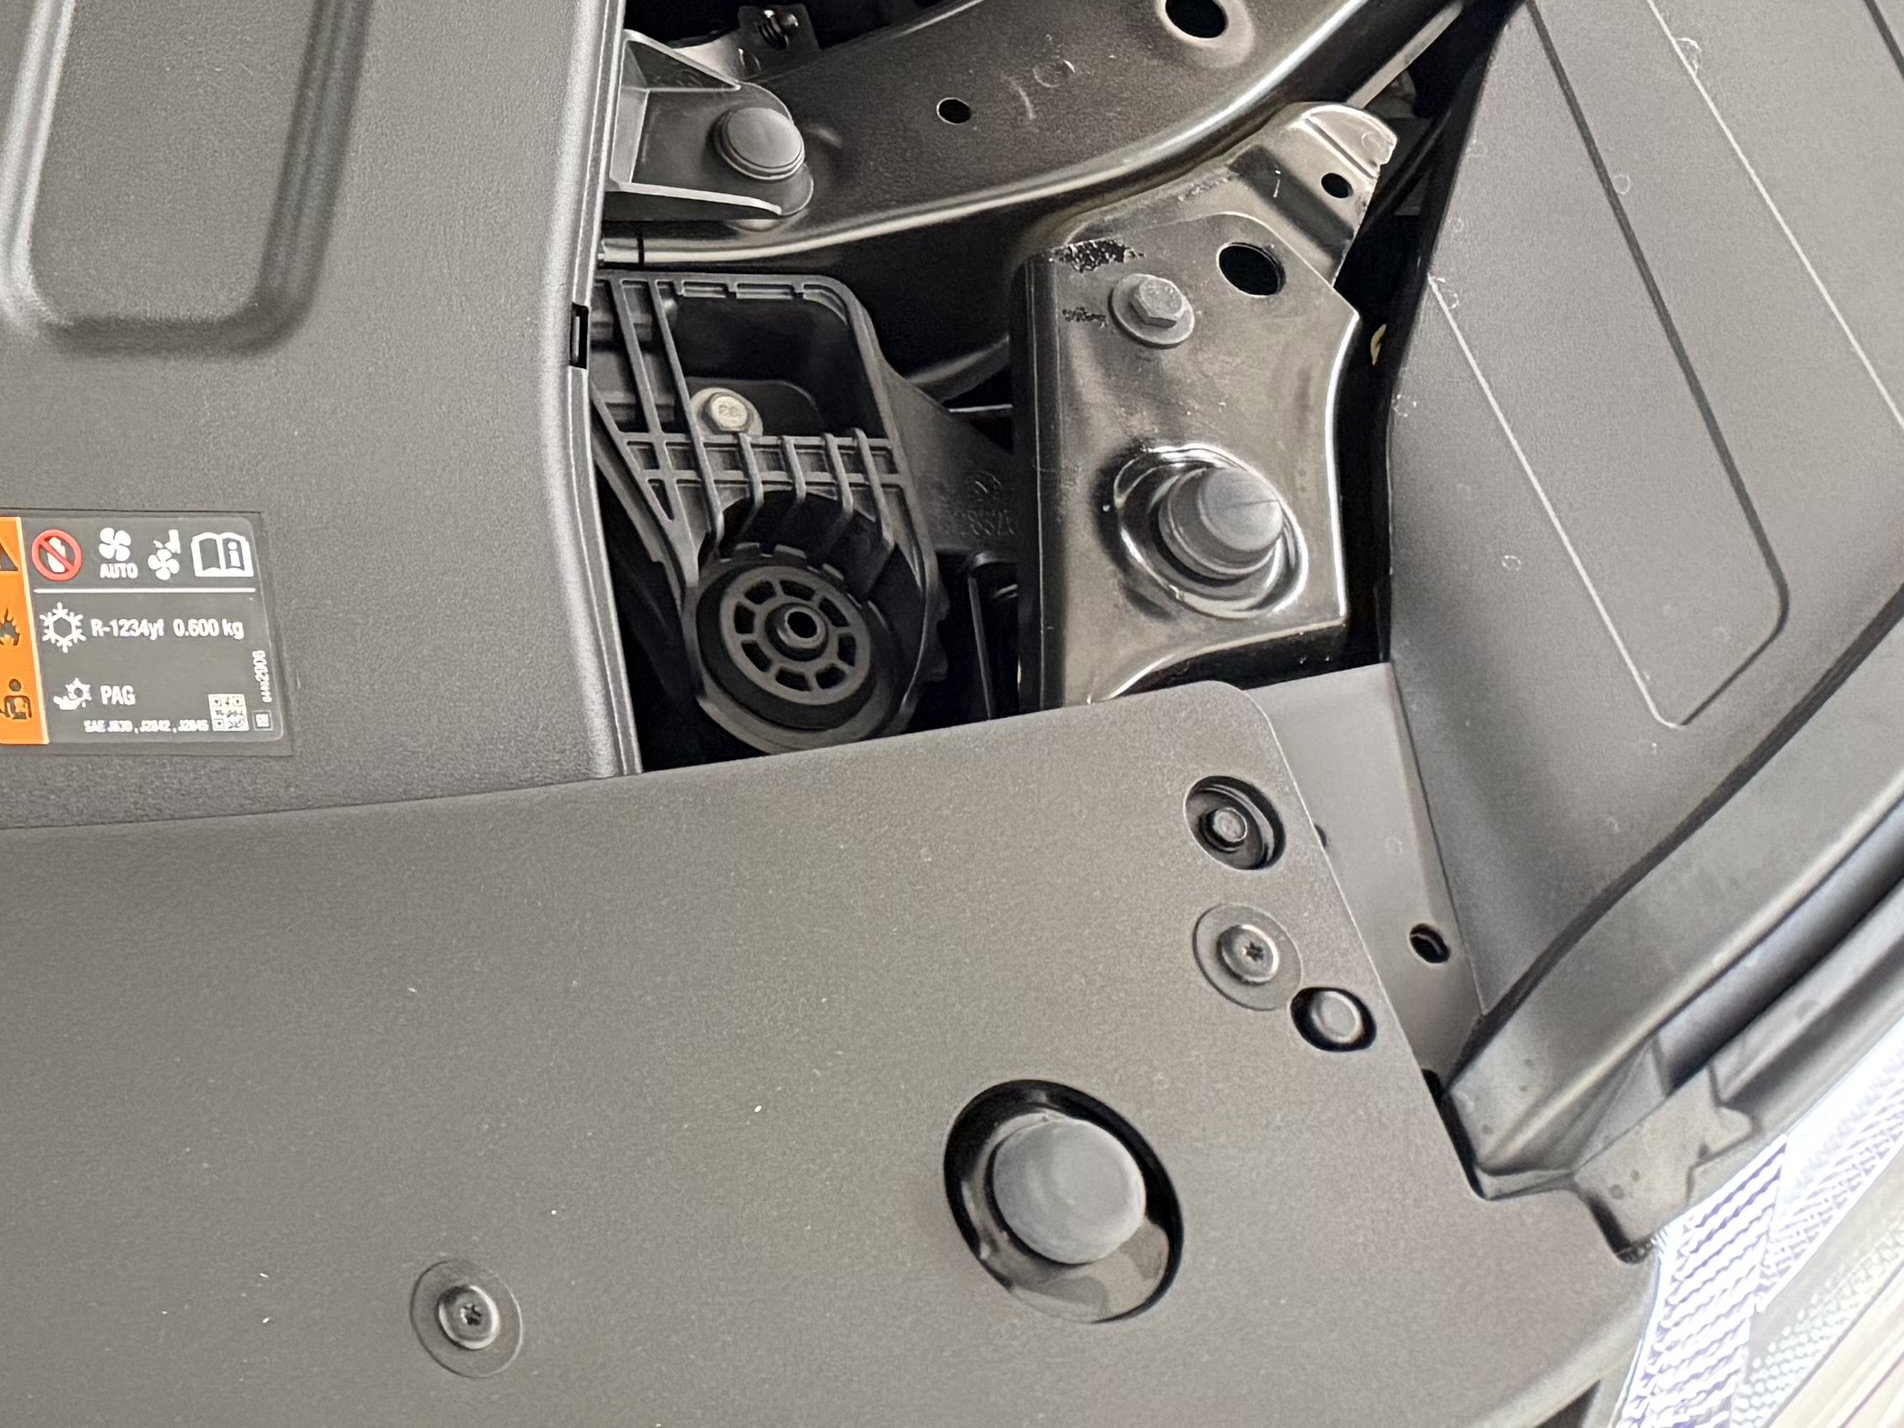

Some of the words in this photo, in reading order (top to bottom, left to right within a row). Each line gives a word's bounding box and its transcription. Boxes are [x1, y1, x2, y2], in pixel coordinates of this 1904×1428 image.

[99, 562, 138, 579] AUTO
[91, 619, 164, 640] R-1234yf
[173, 619, 220, 636] 0.600
[222, 619, 245, 640] kg
[100, 685, 137, 706] PAG
